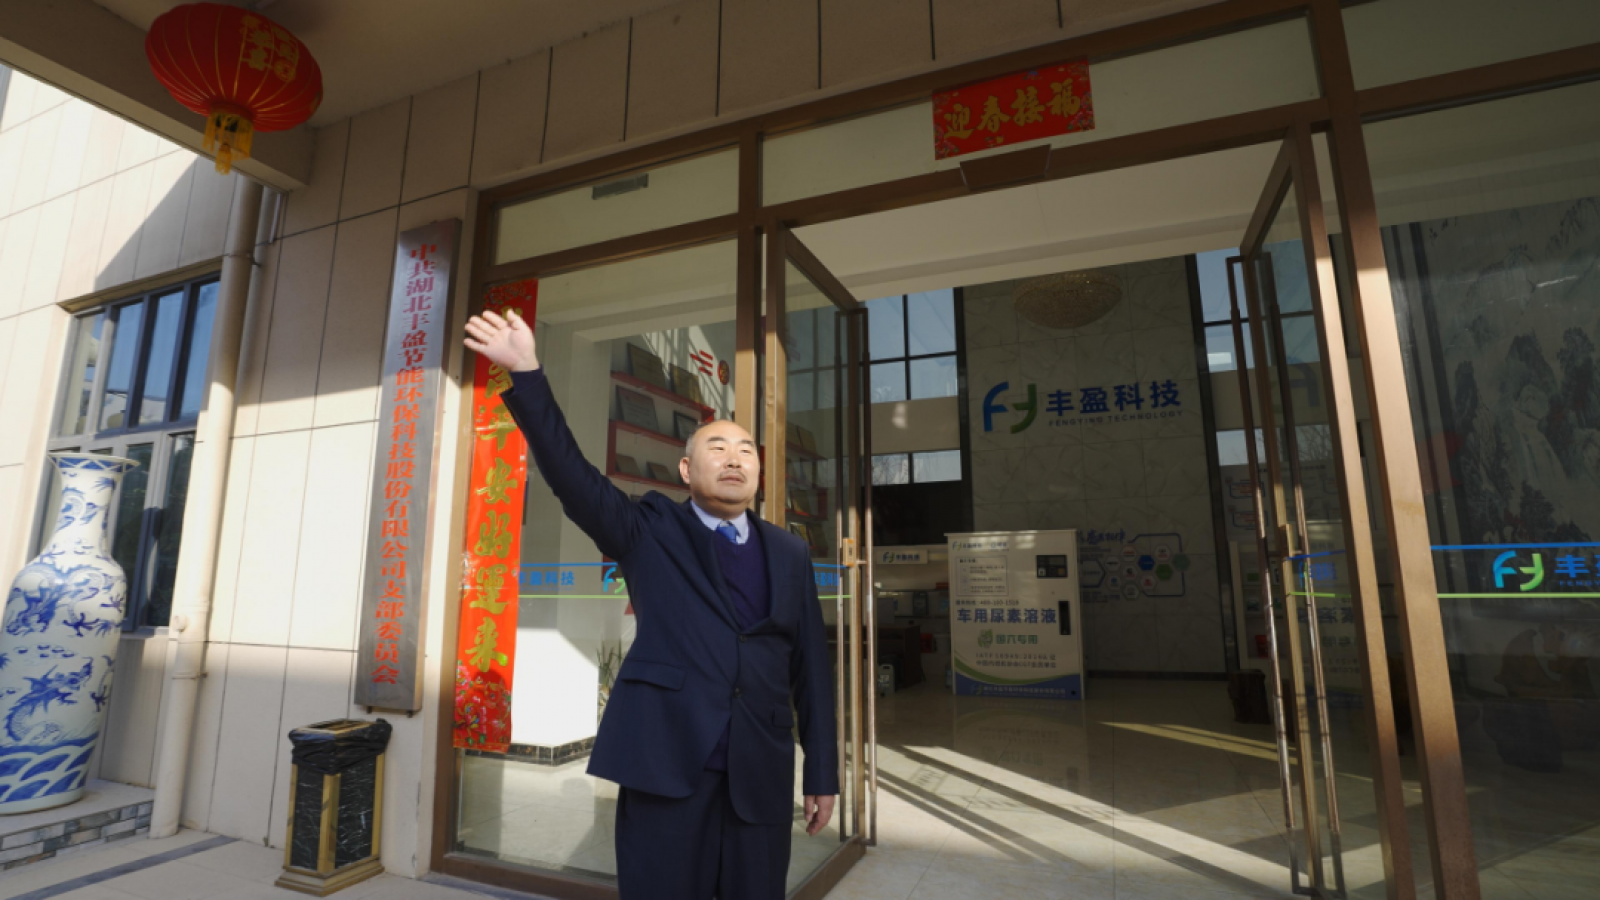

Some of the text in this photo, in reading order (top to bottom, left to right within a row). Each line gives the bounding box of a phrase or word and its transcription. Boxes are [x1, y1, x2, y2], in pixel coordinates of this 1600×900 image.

[943, 78, 1081, 139] 迎春接福
[1046, 379, 1181, 417] 丰盈科技
[1049, 409, 1183, 427] FENGYING TECHNOLOGY
[370, 243, 437, 685] 中共湖北丰盈节能环保科技股份有限公司支部委员会
[957, 608, 1056, 623] 车用尿素溶液
